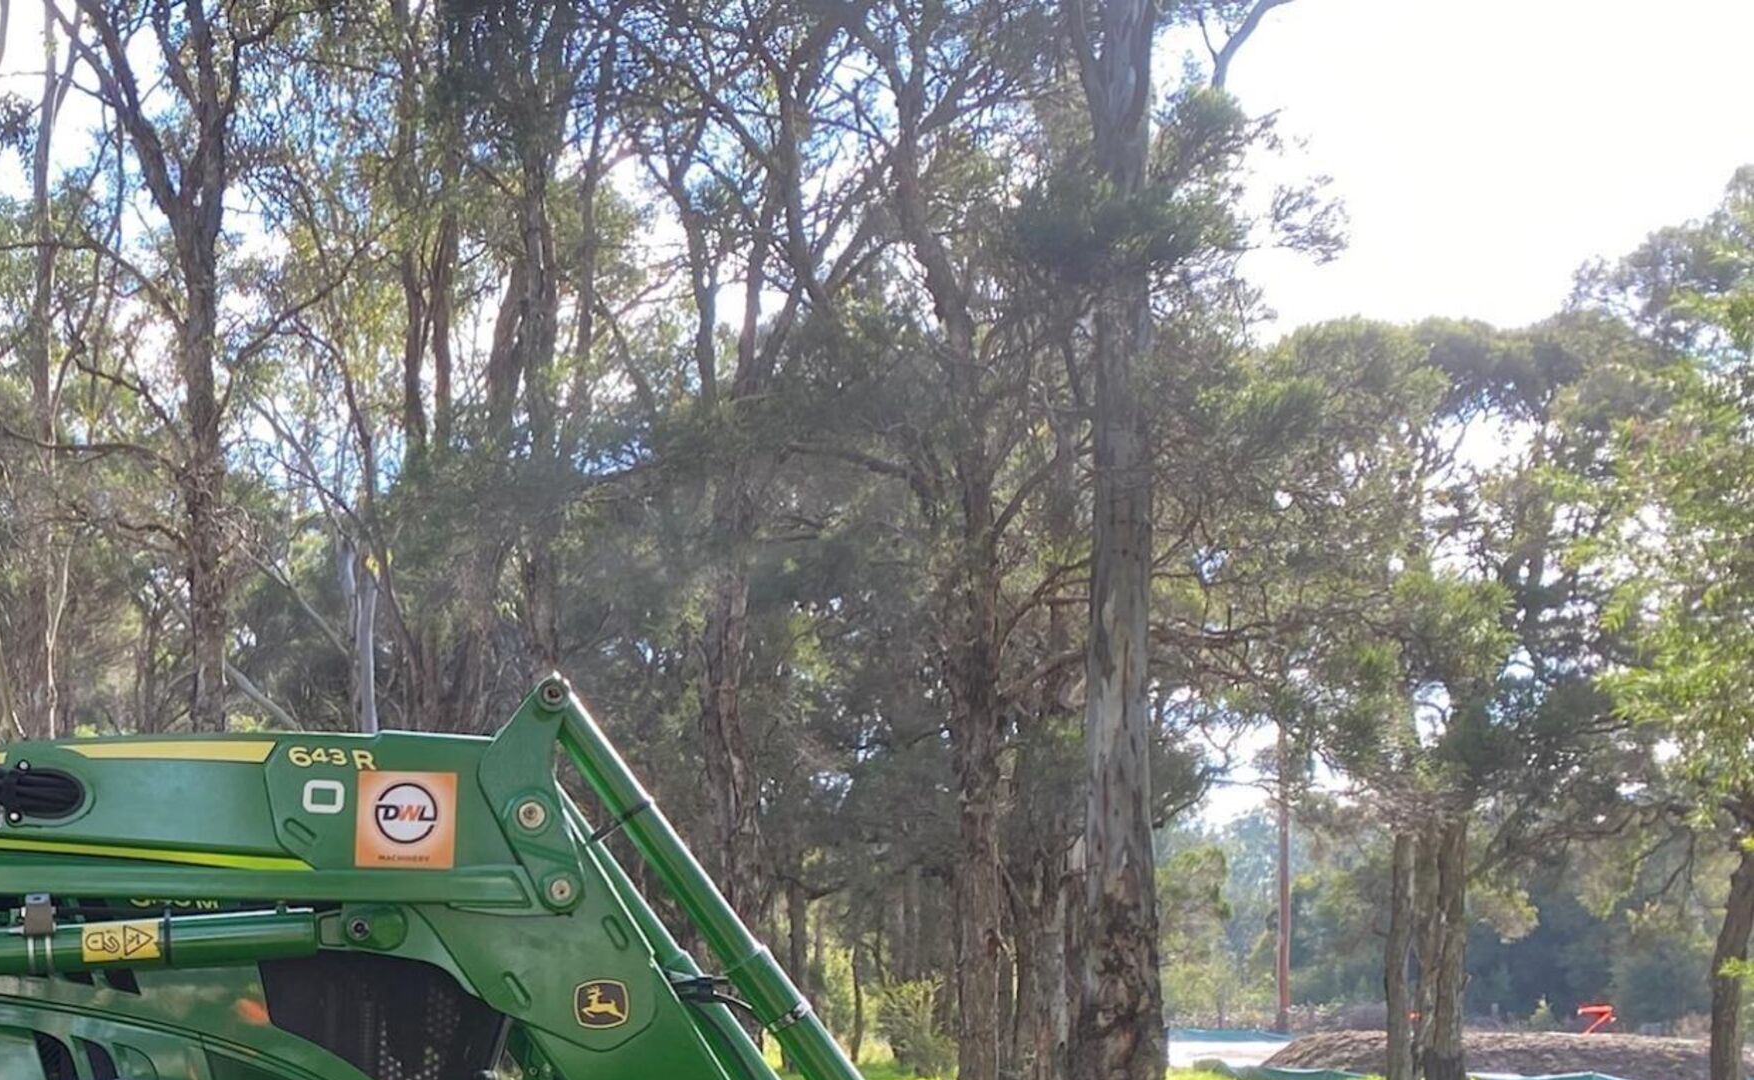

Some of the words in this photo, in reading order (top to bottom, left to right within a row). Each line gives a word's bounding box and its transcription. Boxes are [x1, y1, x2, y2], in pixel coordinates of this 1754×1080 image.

[288, 746, 347, 767] 643
[352, 749, 377, 770] R
[381, 804, 437, 821] DWL
[377, 854, 431, 863] MACHINERY
